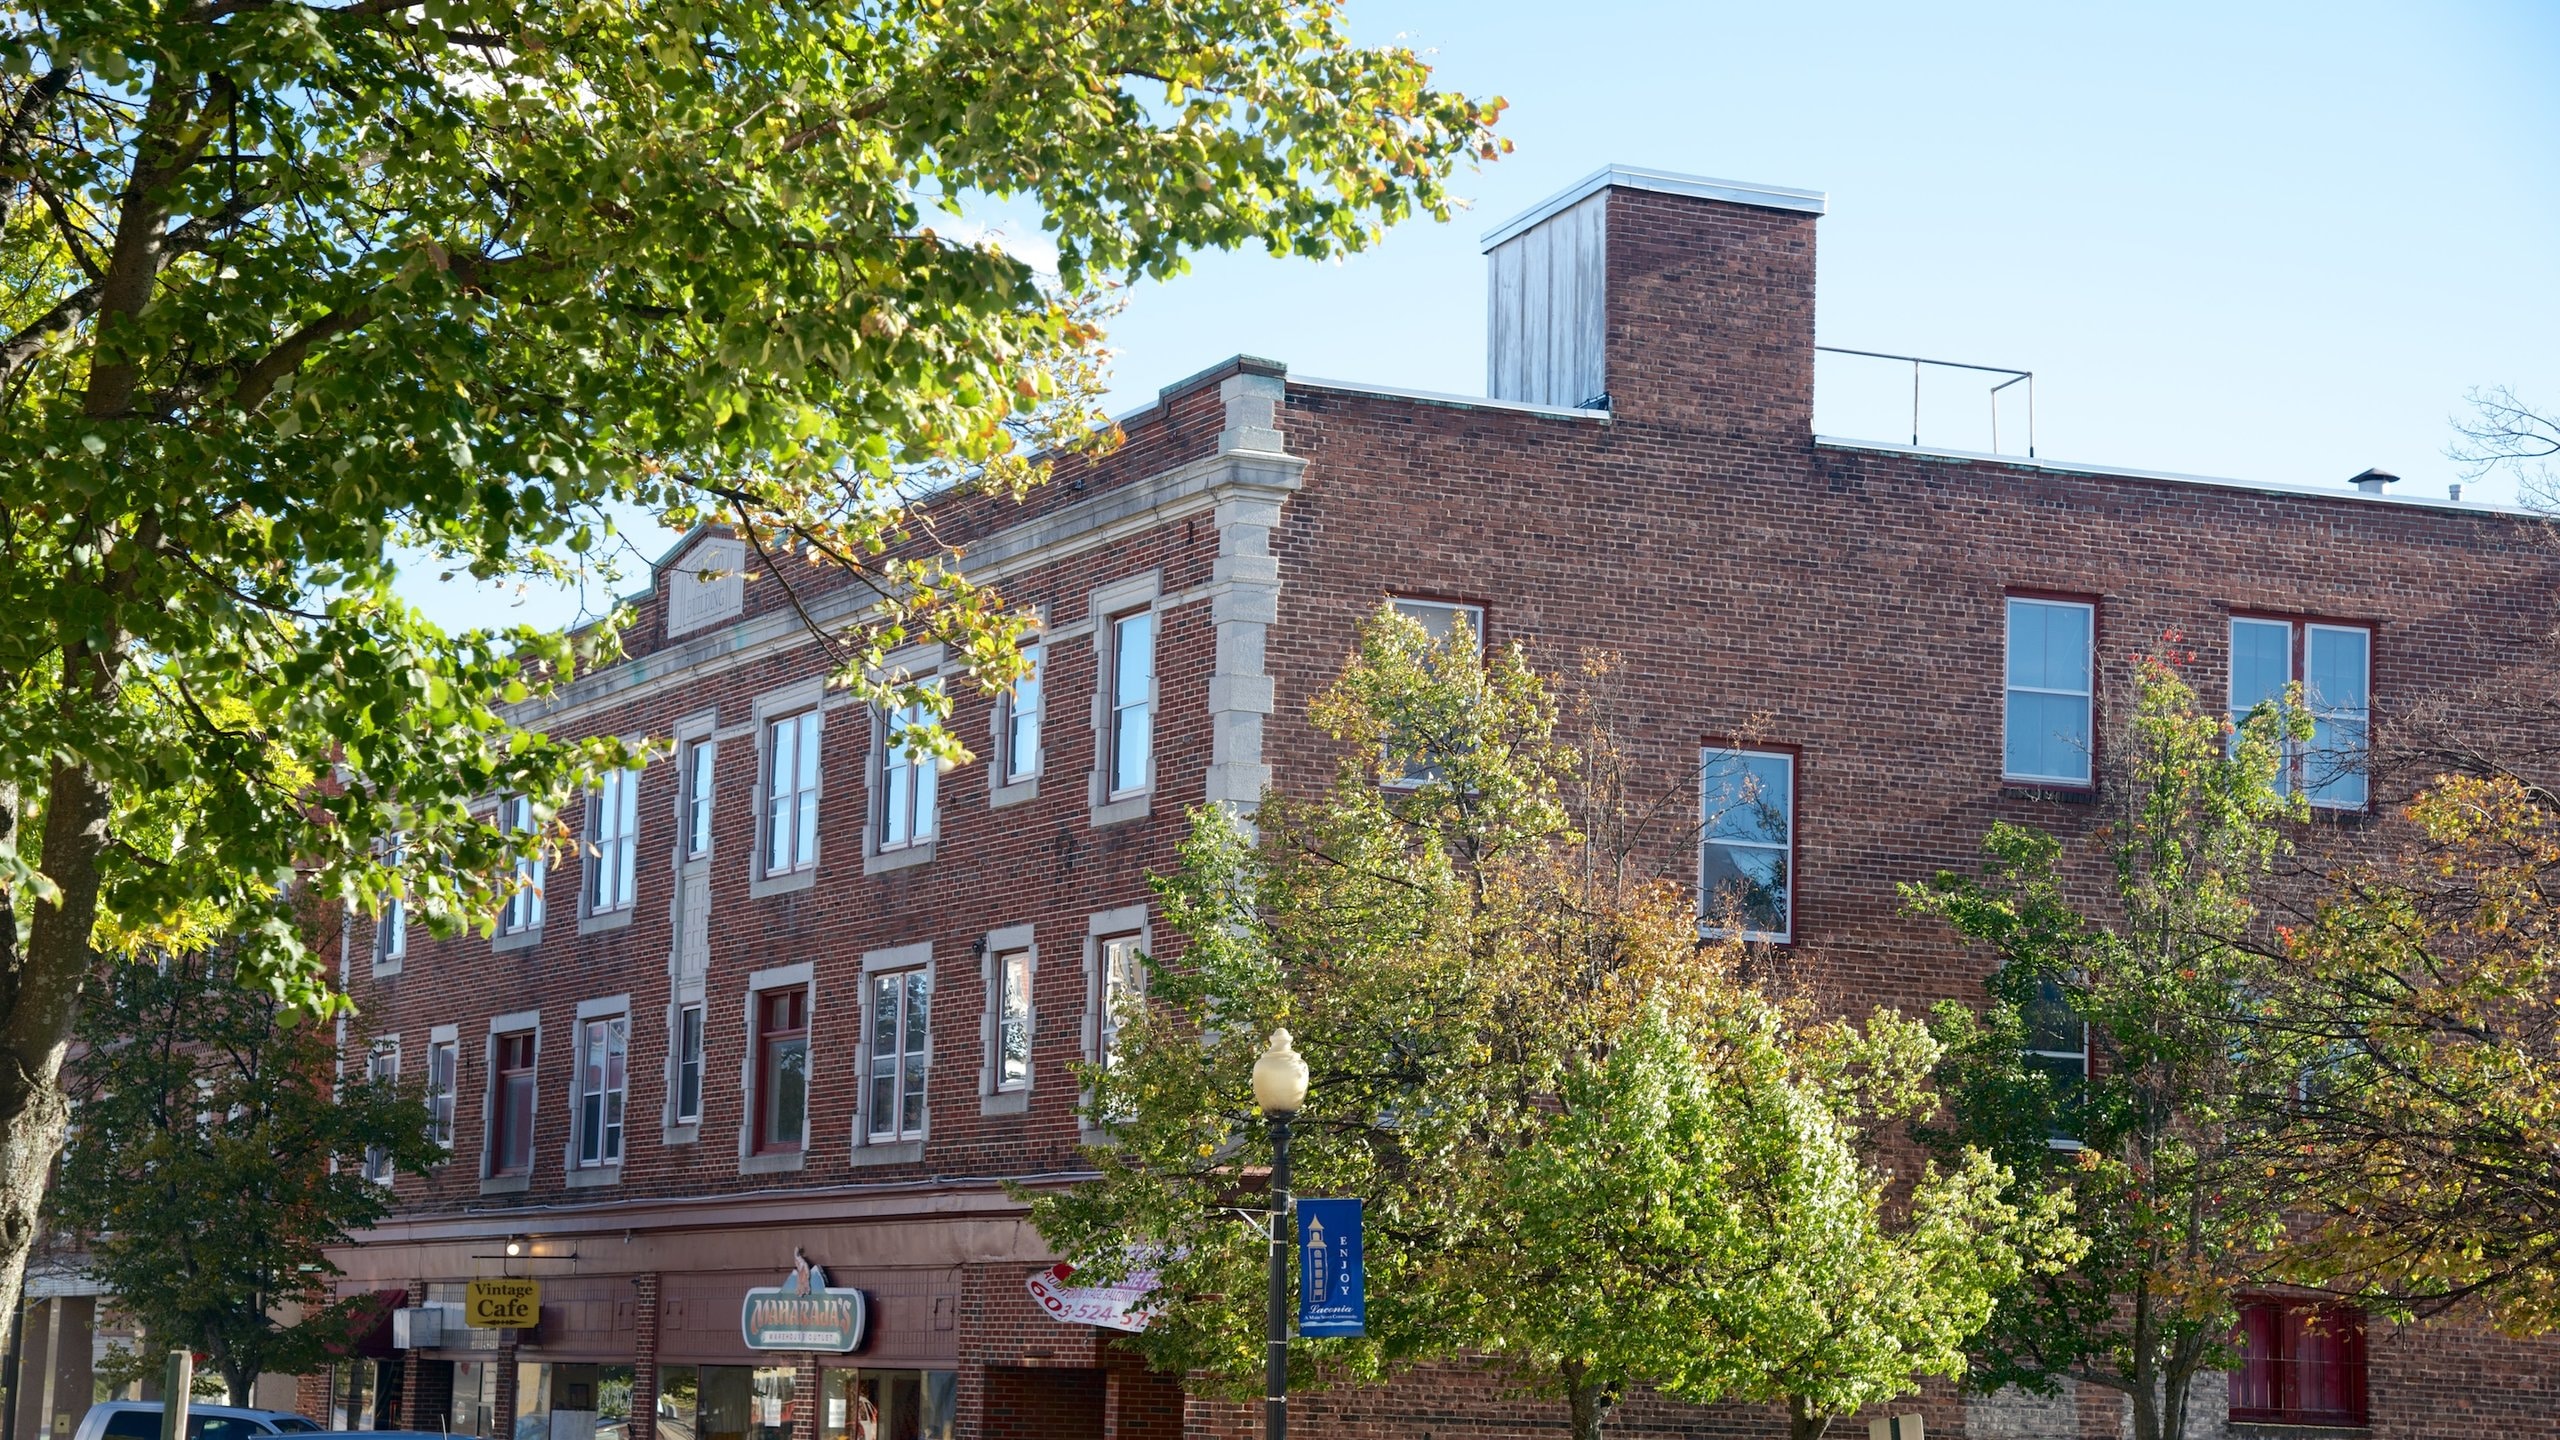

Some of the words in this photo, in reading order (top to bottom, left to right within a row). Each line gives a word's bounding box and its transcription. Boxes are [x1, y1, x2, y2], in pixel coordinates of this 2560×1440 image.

[1339, 1236, 1350, 1295] ENJOY
[475, 1283, 533, 1298] Vintage
[477, 1299, 529, 1317] Cafe
[751, 1297, 852, 1335] MAHARAJA'S
[1308, 1304, 1353, 1314] Laconia
